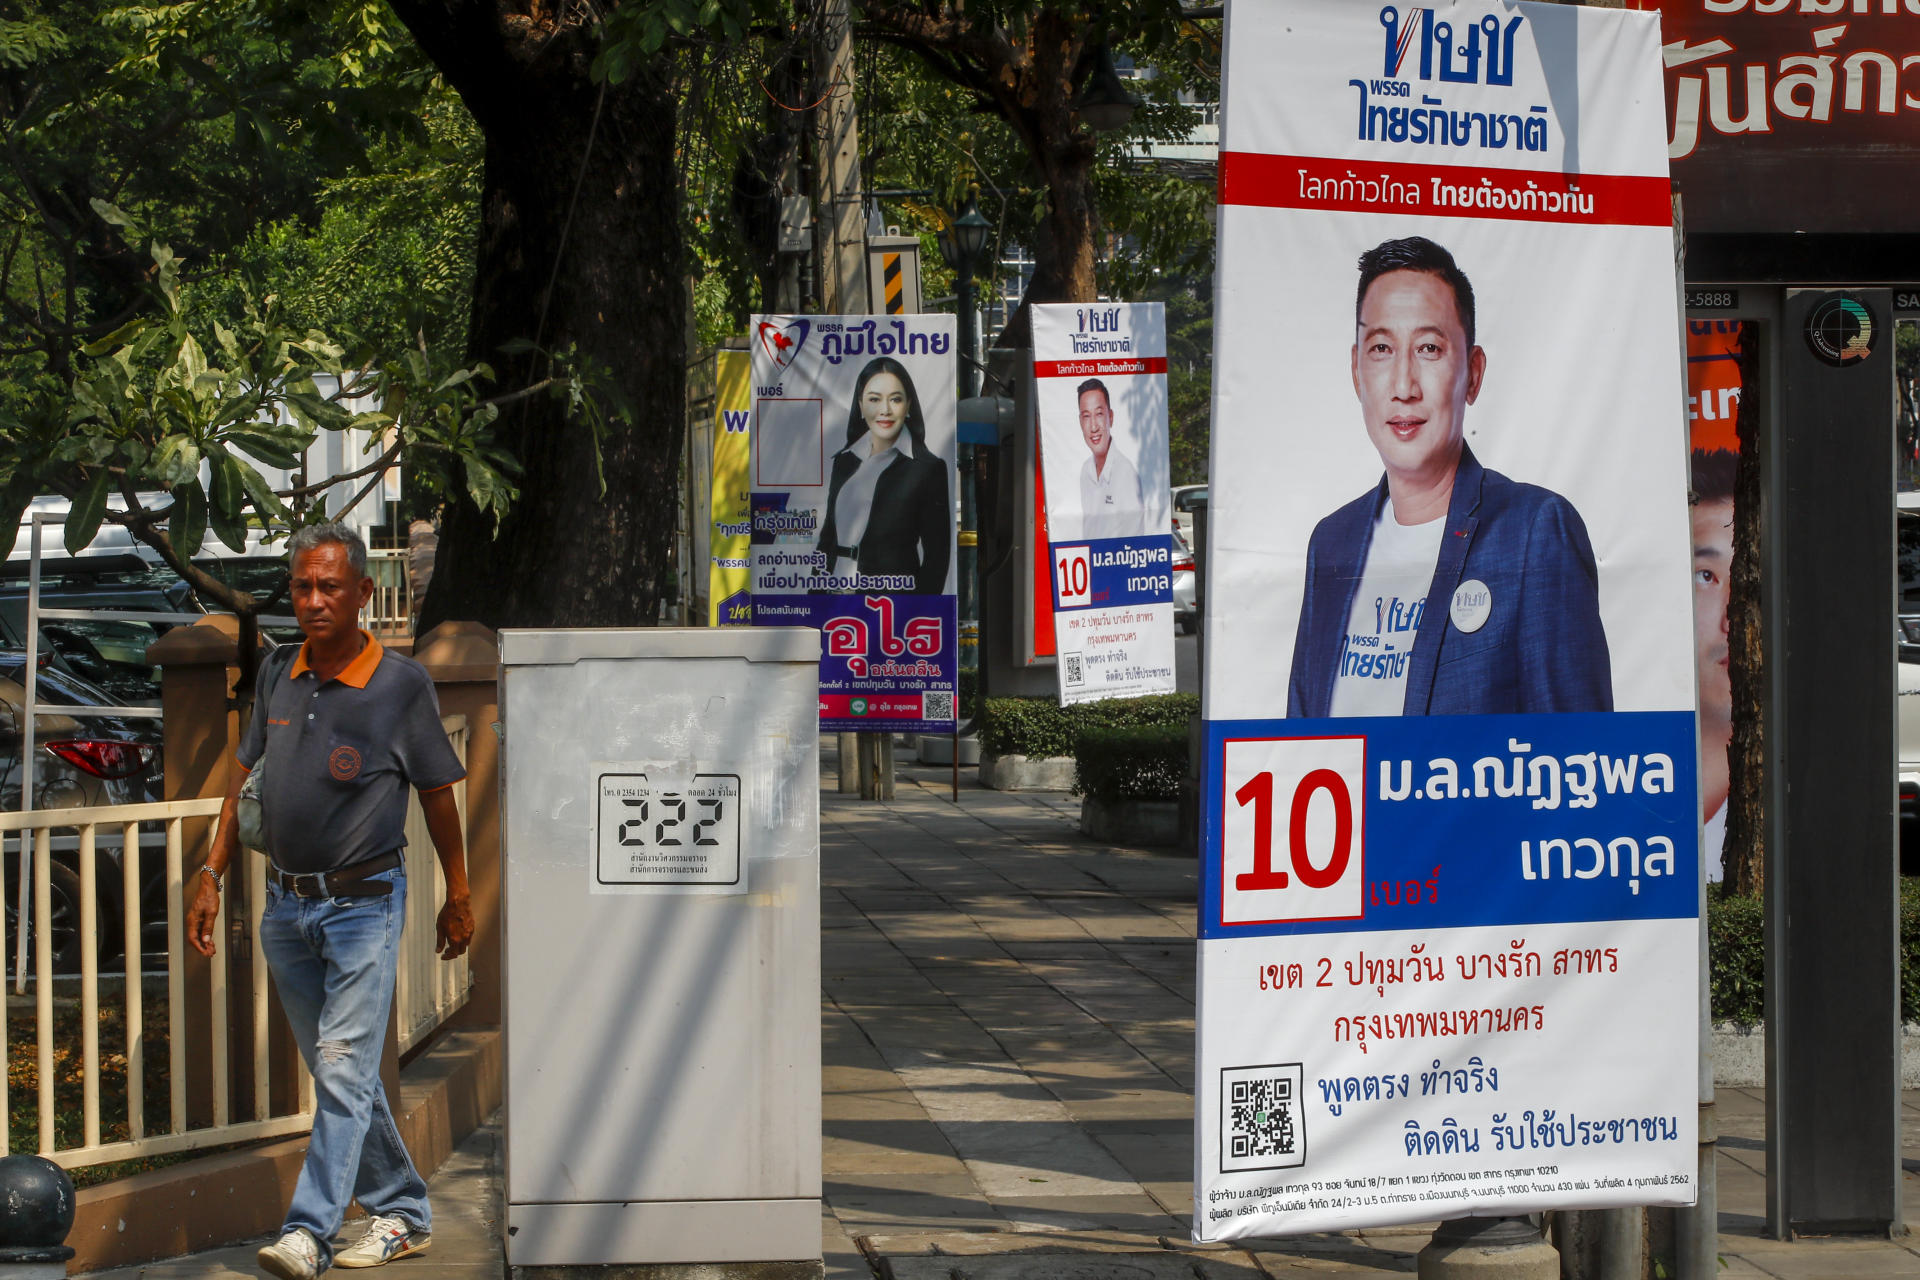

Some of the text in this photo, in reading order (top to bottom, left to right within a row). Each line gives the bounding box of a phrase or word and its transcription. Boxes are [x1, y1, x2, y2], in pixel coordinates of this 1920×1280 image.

[1370, 80, 1410, 98] พรรค
[1349, 79, 1548, 153] ไทยรักษาชาติ
[1297, 169, 1595, 215] โลกก้าวไกล ไทยต้องก้าวทัน
[817, 323, 844, 333] พรรค
[820, 320, 950, 365] ภูมิใจไทย
[1069, 334, 1130, 354] ไทยรักษาชาติ
[1057, 363, 1095, 375] โลกก้าวไกล
[757, 383, 783, 397] เบอร์
[755, 516, 815, 534] กรุงเทพ
[758, 550, 826, 569] ลดอำนาจรัฐ
[758, 569, 915, 590] เพื่อปากท้องประชาชน
[1059, 556, 1088, 597] 10
[1127, 574, 1169, 597] เทวกุล
[757, 604, 811, 616] โปรดสนับสนุน
[1081, 617, 1087, 628] 2
[823, 595, 943, 679] อุไร
[1352, 634, 1380, 647] พรรค
[870, 659, 942, 678] อนันตสิน
[1380, 738, 1674, 810] ม.ล.ณัฏฐพล
[617, 788, 621, 796] 0
[622, 788, 636, 797] 2354
[637, 788, 650, 797] 1234
[708, 788, 715, 796] 24
[619, 799, 723, 846] 222
[1235, 768, 1353, 891] 10
[1521, 835, 1675, 895] เทวกุล
[1371, 864, 1442, 906] เบอร์
[1258, 938, 1619, 997] เขต 2 ปทุมวัน บางรัก สาทร
[1333, 1001, 1546, 1054] กรุงเทพมหานคร
[1317, 1055, 1499, 1117] พูดตรง ทำจริง
[1403, 1110, 1678, 1158] ติดดิน รับใช้ประชาชน
[1311, 1181, 1323, 1191] 93
[1368, 1175, 1386, 1189] 18/7
[1537, 1165, 1559, 1176] 10210
[1331, 1196, 1362, 1209] 24/2-3
[1507, 1184, 1530, 1195] 11000
[1557, 1181, 1573, 1191] 430
[1670, 1174, 1689, 1185] 2562
